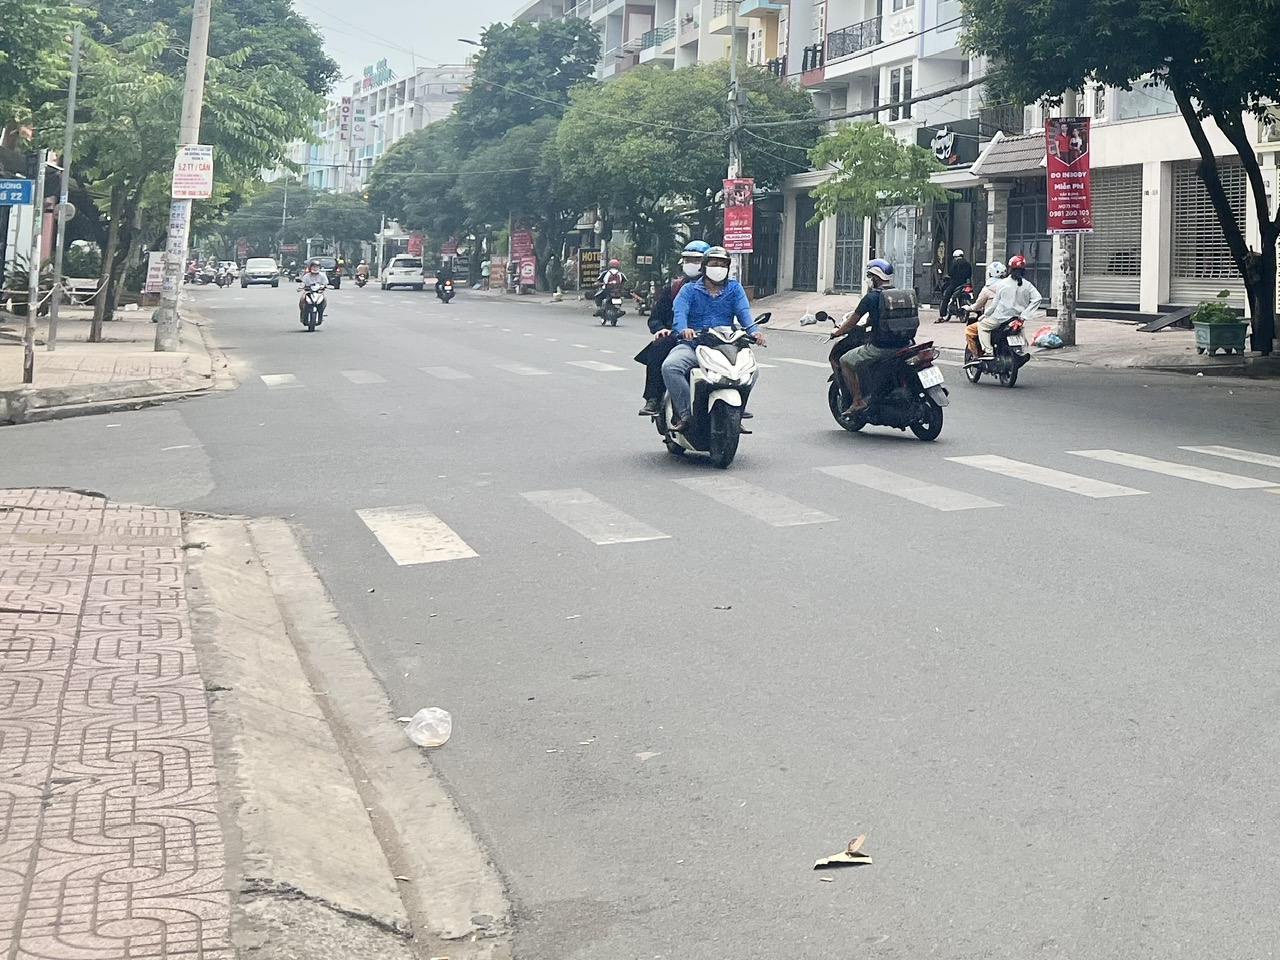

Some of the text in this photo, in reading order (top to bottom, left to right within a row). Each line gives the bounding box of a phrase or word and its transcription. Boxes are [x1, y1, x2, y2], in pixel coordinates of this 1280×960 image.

[341, 97, 352, 140] MOTEL
[0, 182, 22, 190] ƯỜNG
[10, 192, 23, 201] 22
[582, 252, 602, 262] HOTE
